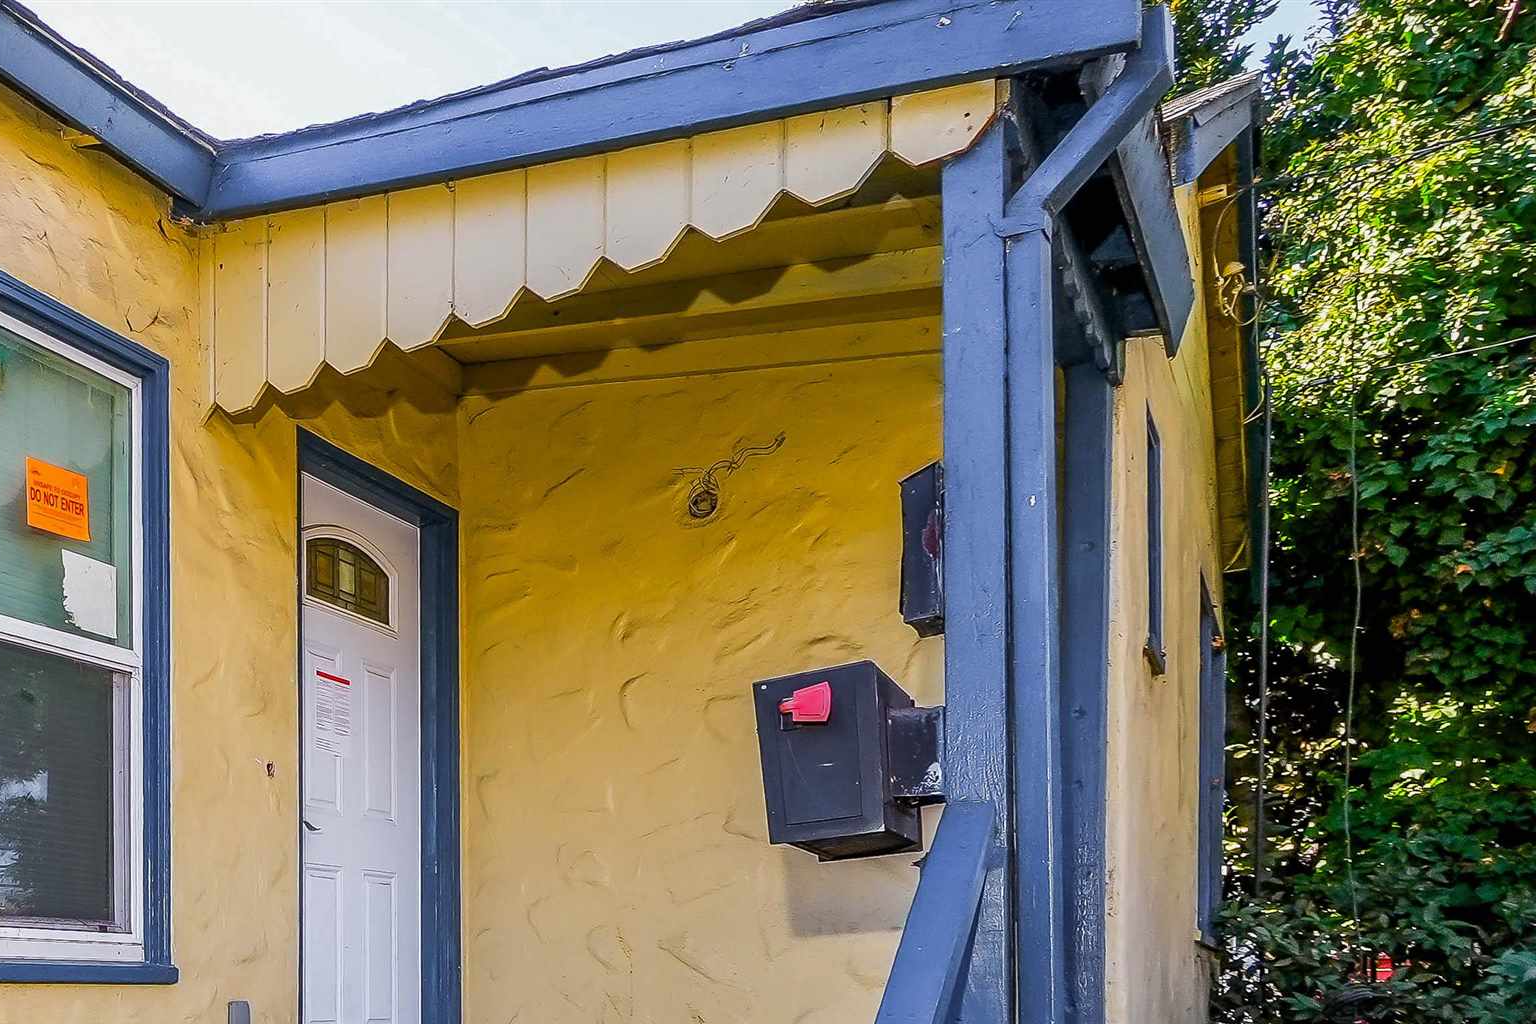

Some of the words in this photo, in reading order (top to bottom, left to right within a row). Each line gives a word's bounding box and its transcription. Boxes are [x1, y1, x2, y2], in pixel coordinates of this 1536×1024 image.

[30, 487, 42, 503] DO
[44, 492, 59, 507] NOT
[60, 497, 85, 517] ENTER
